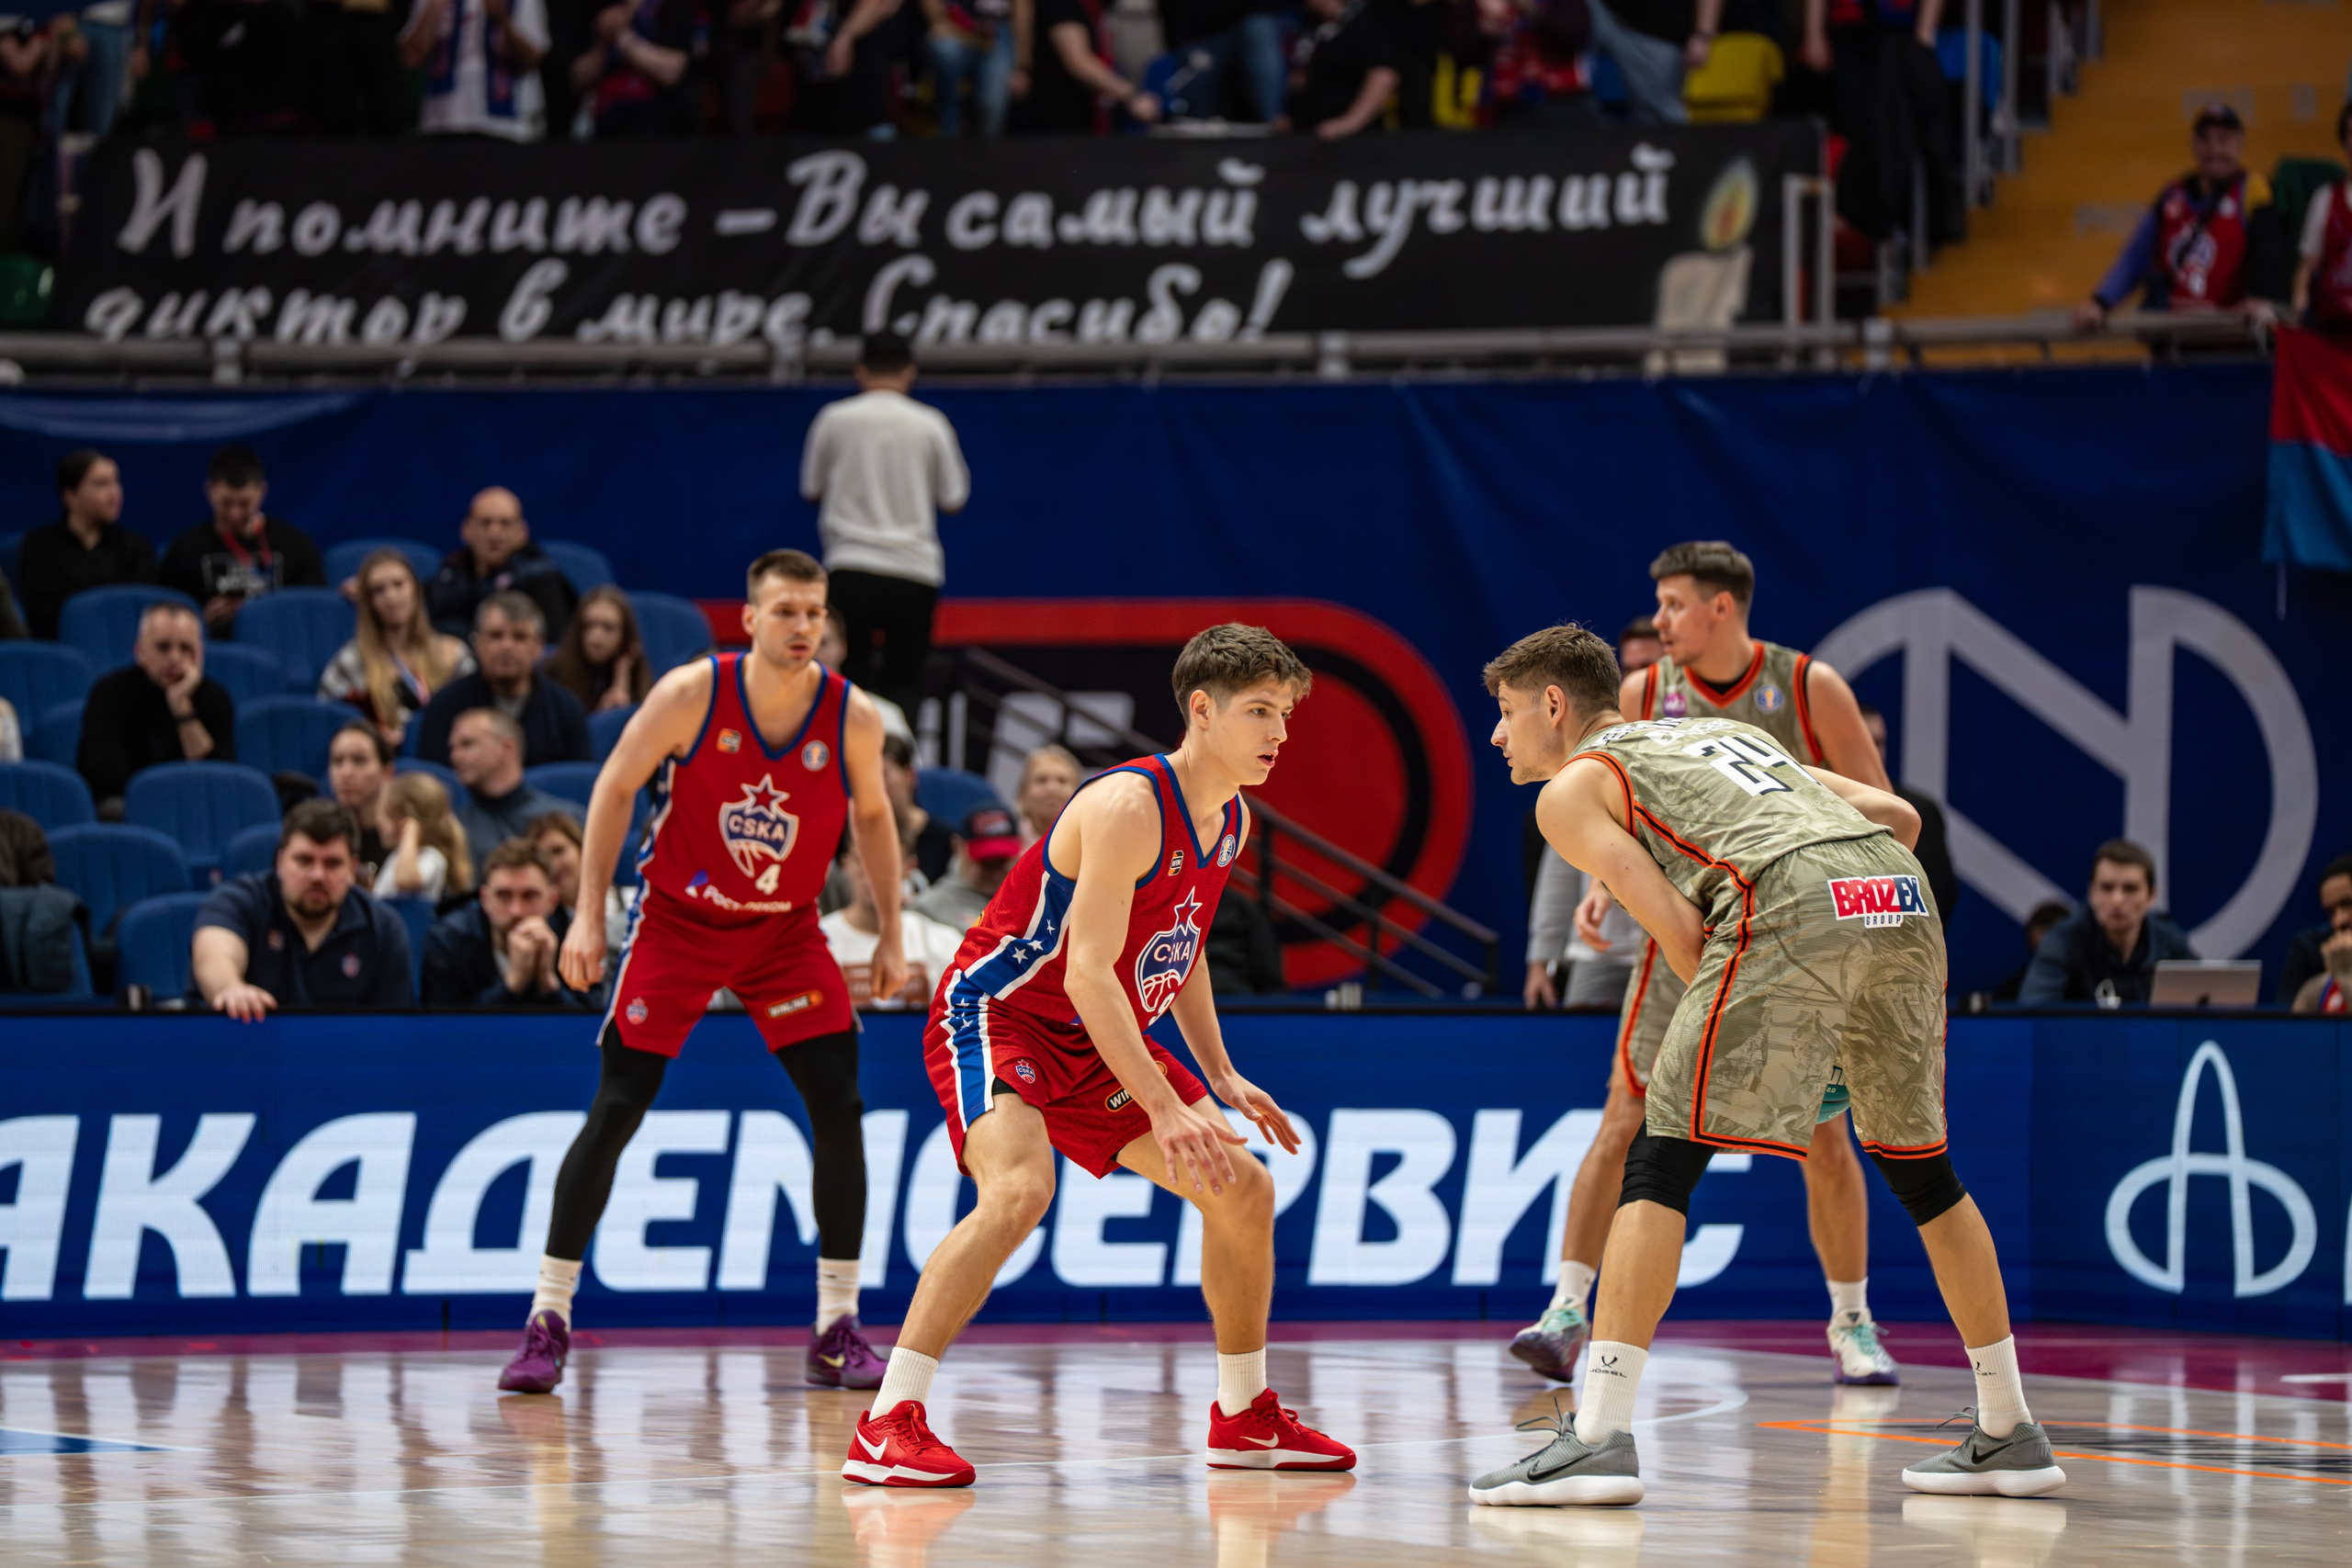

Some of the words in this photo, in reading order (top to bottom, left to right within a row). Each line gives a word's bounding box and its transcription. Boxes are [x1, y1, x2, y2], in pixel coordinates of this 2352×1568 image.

[118, 148, 208, 257] И
[223, 192, 688, 256] помните
[944, 156, 1266, 250] самый
[1299, 144, 1676, 280] лучший
[85, 287, 468, 344] диктор
[499, 259, 567, 344] в
[863, 254, 1294, 344] Спасибо!
[1681, 732, 1822, 797] 24
[729, 814, 786, 840] CSKA
[754, 863, 782, 896] 4
[1866, 914, 1902, 926] GROUP
[1153, 941, 1192, 964] CSKA
